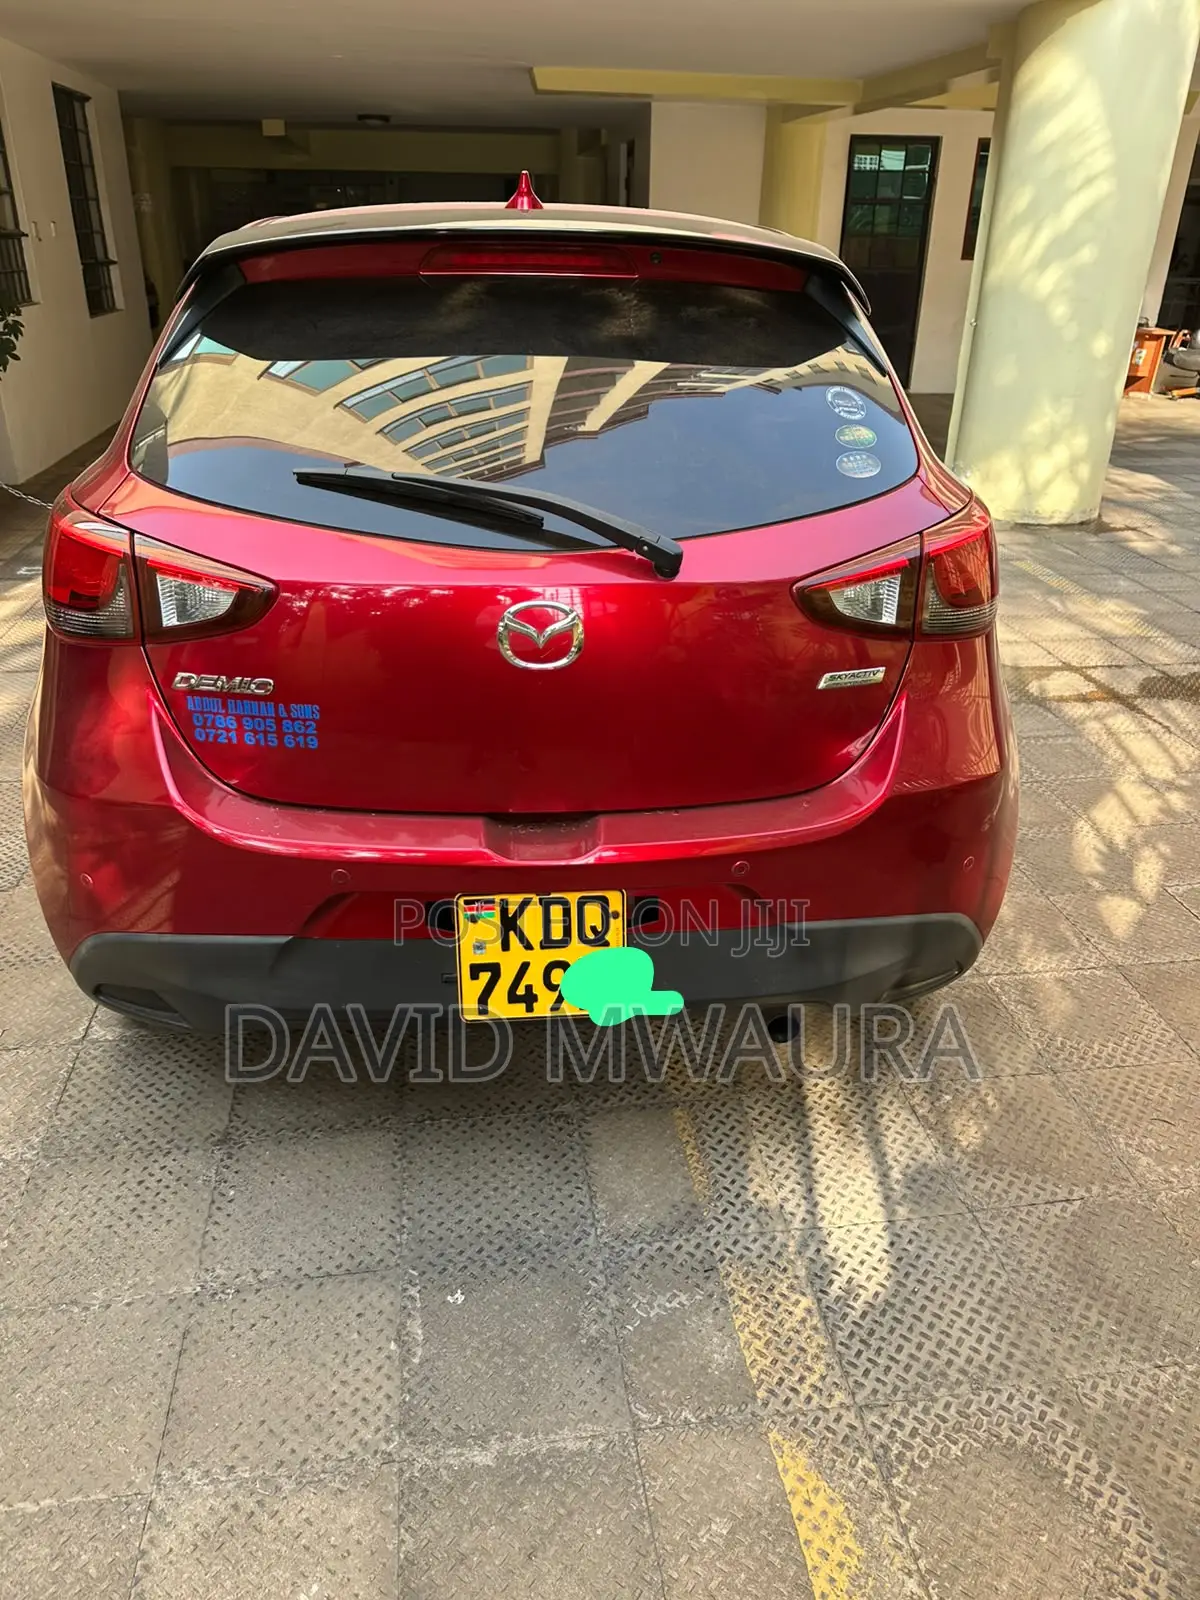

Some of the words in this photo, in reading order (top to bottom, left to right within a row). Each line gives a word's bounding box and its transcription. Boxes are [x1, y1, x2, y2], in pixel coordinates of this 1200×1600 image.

[172, 672, 274, 696] DEMIO
[828, 670, 880, 681] SKYACTIV
[290, 704, 320, 719] SONS
[192, 713, 237, 729] 0786
[242, 717, 276, 732] 905
[282, 720, 317, 734] 862
[195, 728, 238, 744] 0721
[244, 732, 278, 747] 615
[284, 734, 318, 749] 619
[500, 895, 611, 952] KDQ
[469, 959, 590, 1016] 749
